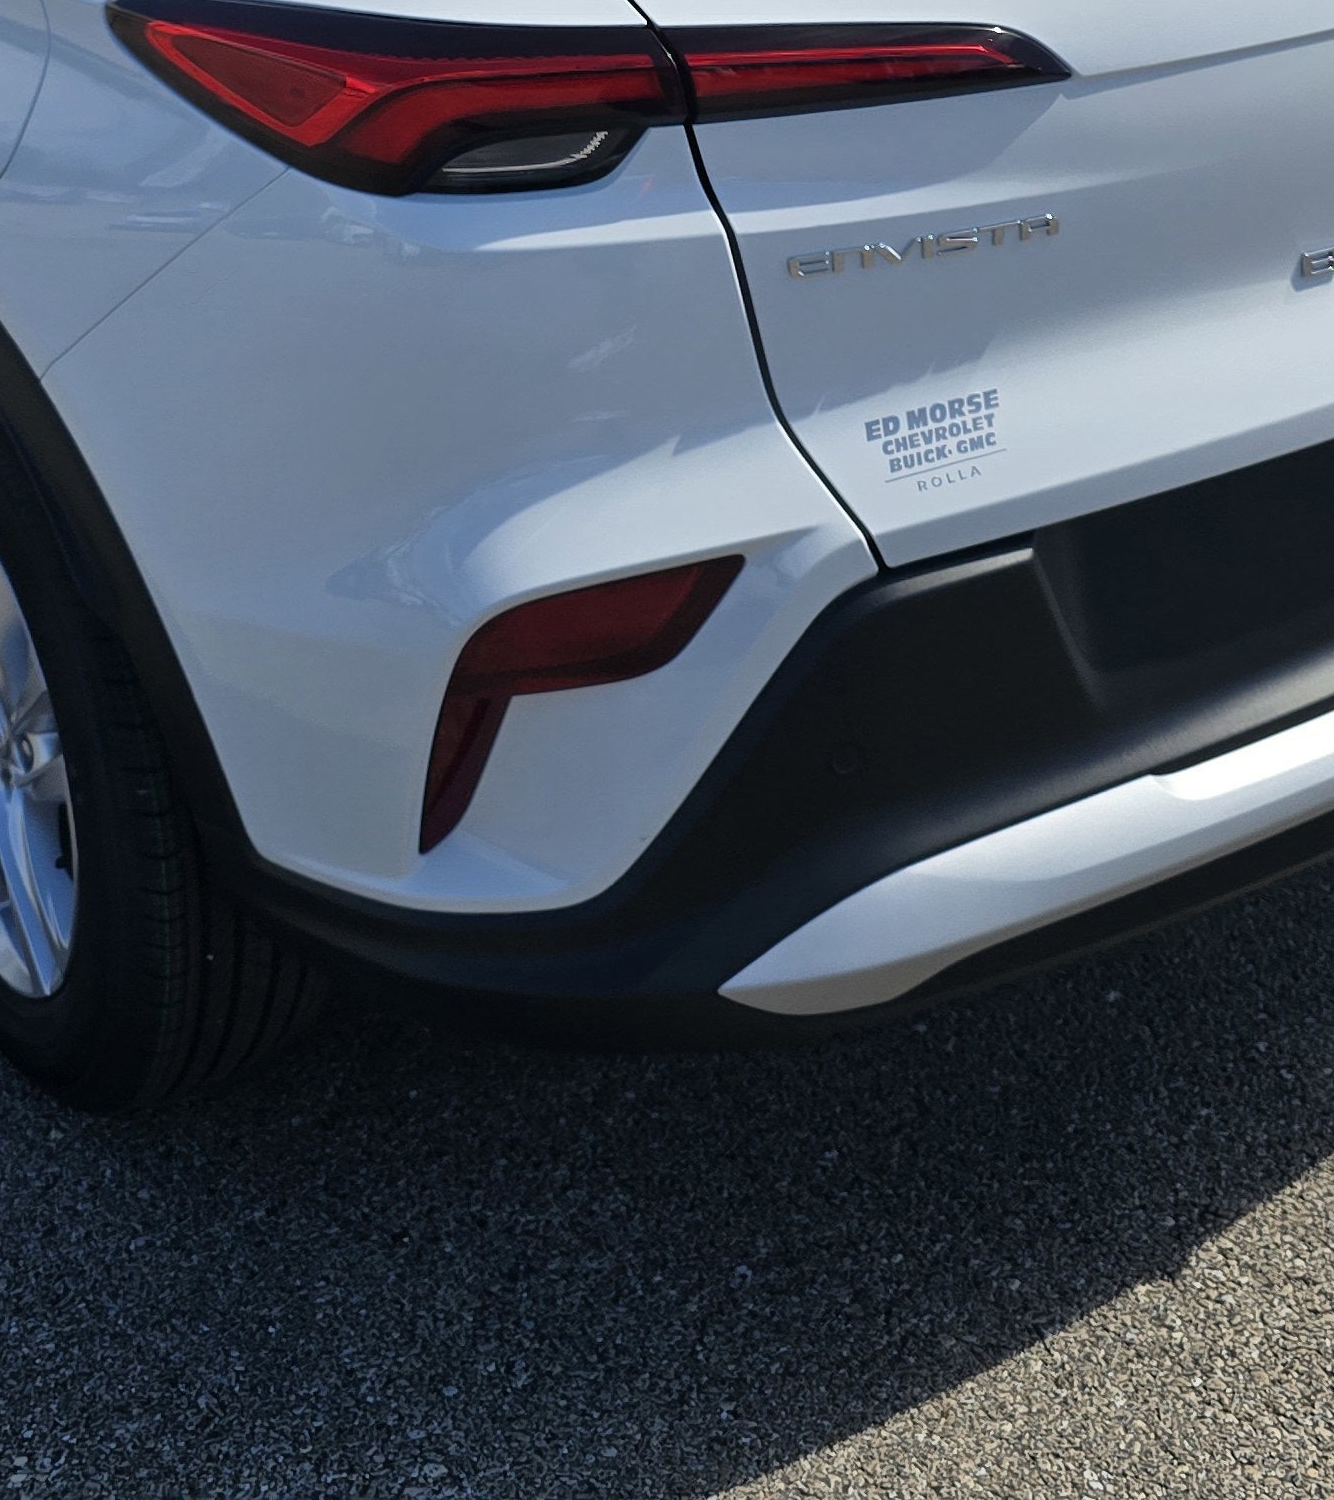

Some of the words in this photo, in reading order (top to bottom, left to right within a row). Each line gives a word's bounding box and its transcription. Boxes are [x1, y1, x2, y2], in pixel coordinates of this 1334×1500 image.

[787, 212, 1060, 278] ENVISTA
[864, 415, 901, 442] ED
[906, 388, 1000, 431] MORSE
[882, 413, 996, 455] CHEVROLET
[916, 465, 982, 492] ROLLA
